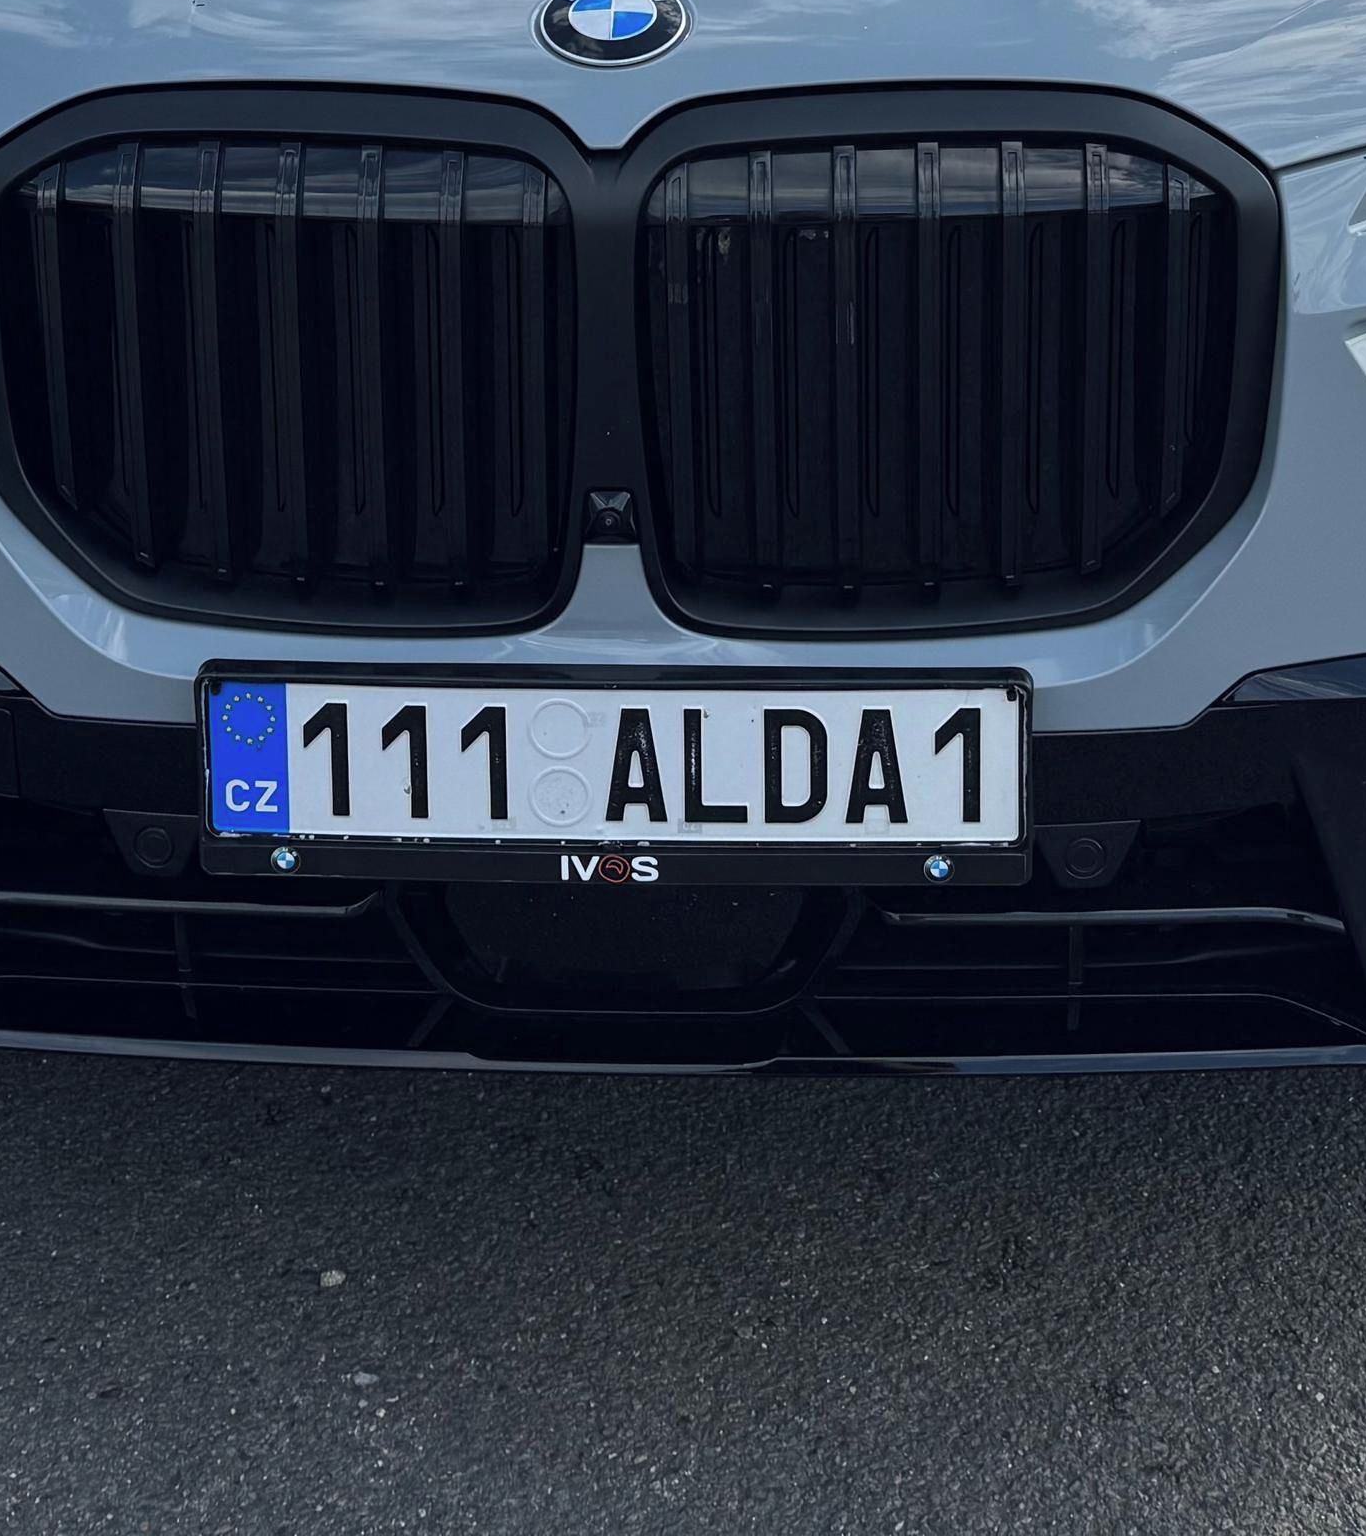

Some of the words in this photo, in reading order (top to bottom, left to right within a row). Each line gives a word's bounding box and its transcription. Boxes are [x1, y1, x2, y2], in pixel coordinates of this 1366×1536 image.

[225, 779, 278, 813] CZ
[303, 703, 509, 820] 111
[605, 707, 981, 823] ALDA1
